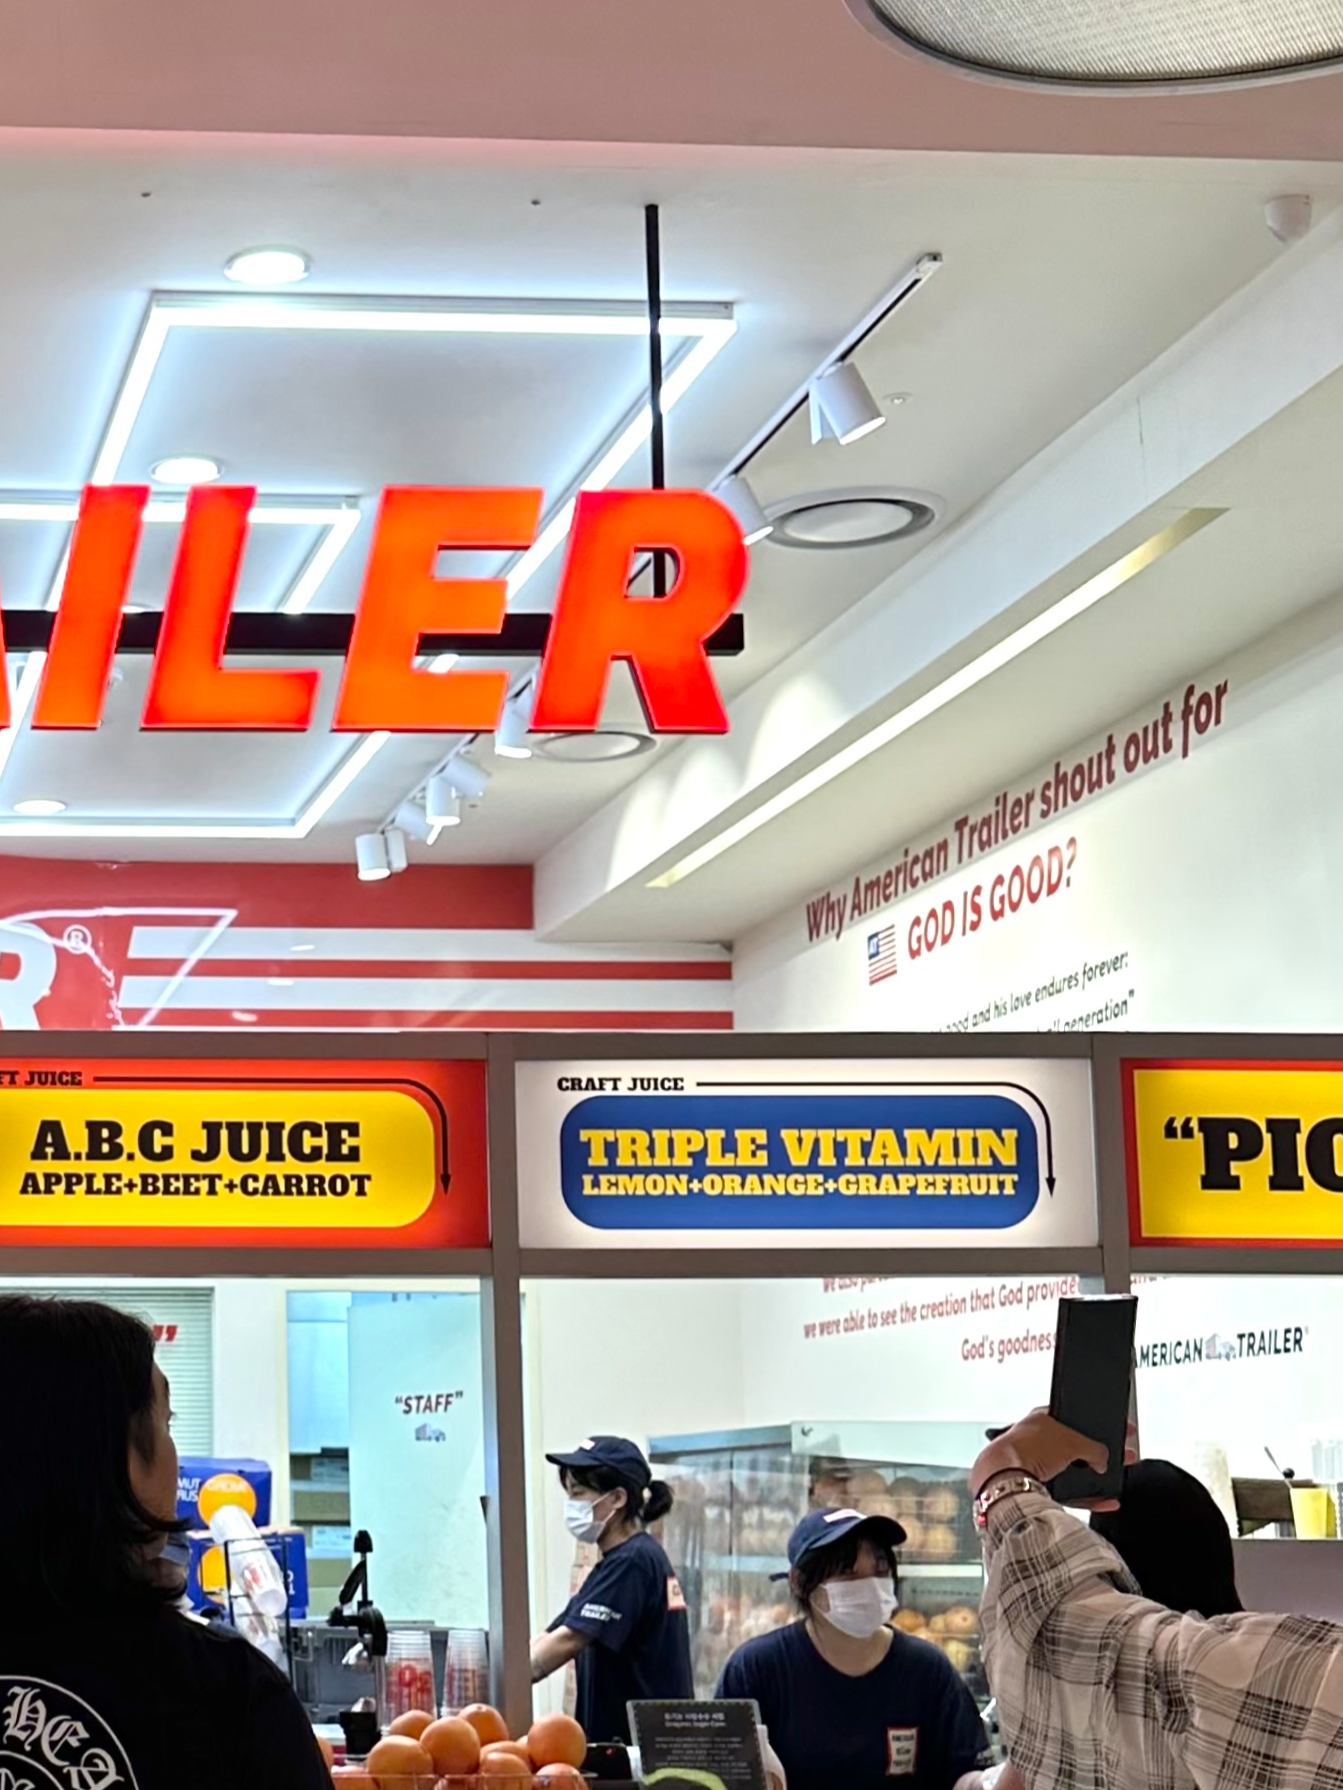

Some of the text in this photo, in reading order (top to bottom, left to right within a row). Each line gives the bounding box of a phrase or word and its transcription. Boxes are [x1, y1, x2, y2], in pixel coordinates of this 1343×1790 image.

[807, 679, 1228, 941] Why American Trailer shout out for
[907, 837, 1077, 960] GOD IS GOOD?
[972, 1003, 990, 1028] and
[993, 997, 1007, 1019] his
[1010, 989, 1032, 1013] love
[1035, 971, 1079, 1003] endures
[1082, 951, 1128, 991] forever:
[24, 1071, 83, 1086] JUICE
[557, 1076, 685, 1092] CRAFT JUICE
[30, 1120, 360, 1163] A.B.C JUICE
[579, 1127, 1019, 1167] TRIPLE VITAMIN
[20, 1172, 372, 1198] APPLE+BEET+CARROT
[581, 1173, 1018, 1197] LEMON+ORANGE+GRAPEFRUIT
[804, 1276, 1079, 1339] we were able to see the creation that God provide
[961, 1334, 994, 1361] God's
[1237, 1326, 1303, 1360] TRAILER
